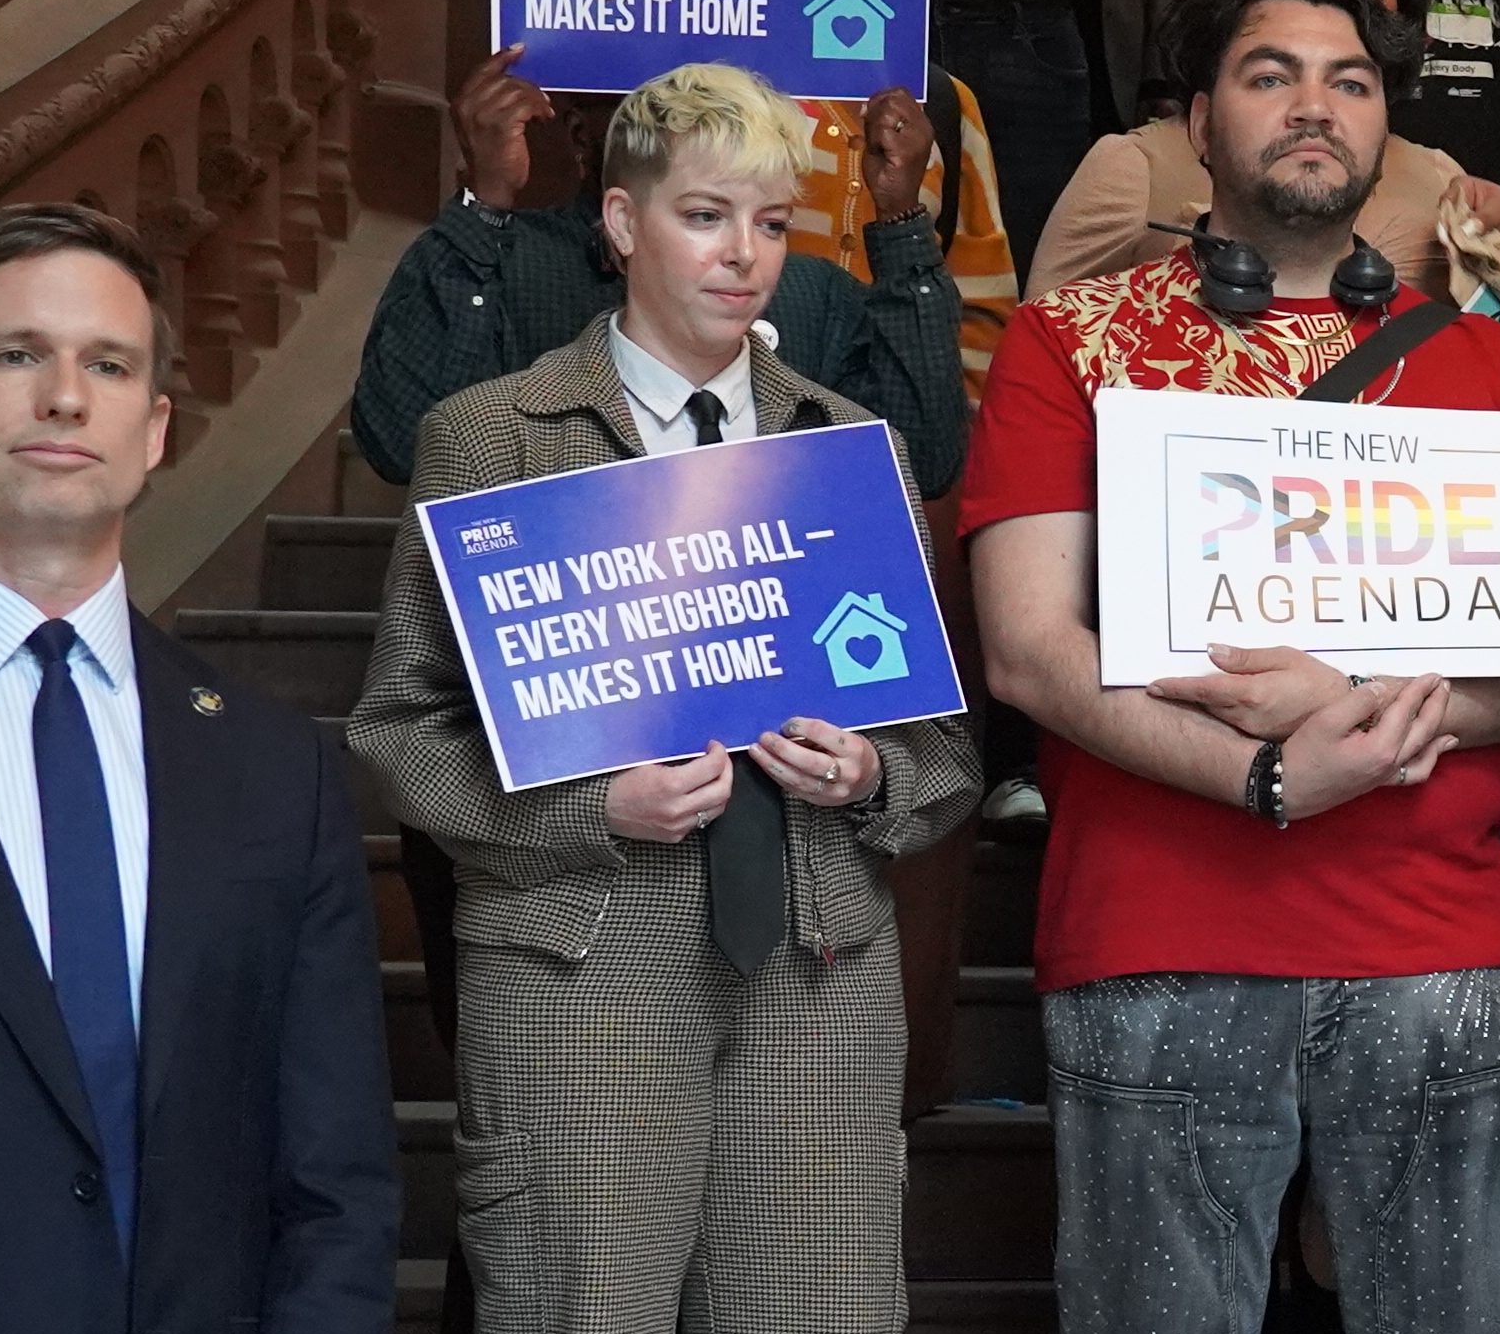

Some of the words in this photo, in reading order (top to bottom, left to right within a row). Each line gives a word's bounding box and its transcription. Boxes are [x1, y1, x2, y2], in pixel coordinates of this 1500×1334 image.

[1271, 428, 1333, 459] THE
[1344, 432, 1419, 464] NEW
[460, 522, 514, 545] PRIDE
[466, 535, 519, 555] AGENDA
[479, 561, 564, 615] NEW
[567, 542, 661, 596] YORK
[667, 529, 738, 578] FOR
[742, 519, 805, 566] ALL
[495, 611, 609, 668] EVERY
[621, 577, 790, 643] NEIGHBOR
[512, 658, 642, 721] MAKES
[640, 650, 677, 695] IT
[682, 634, 783, 689] HOME
